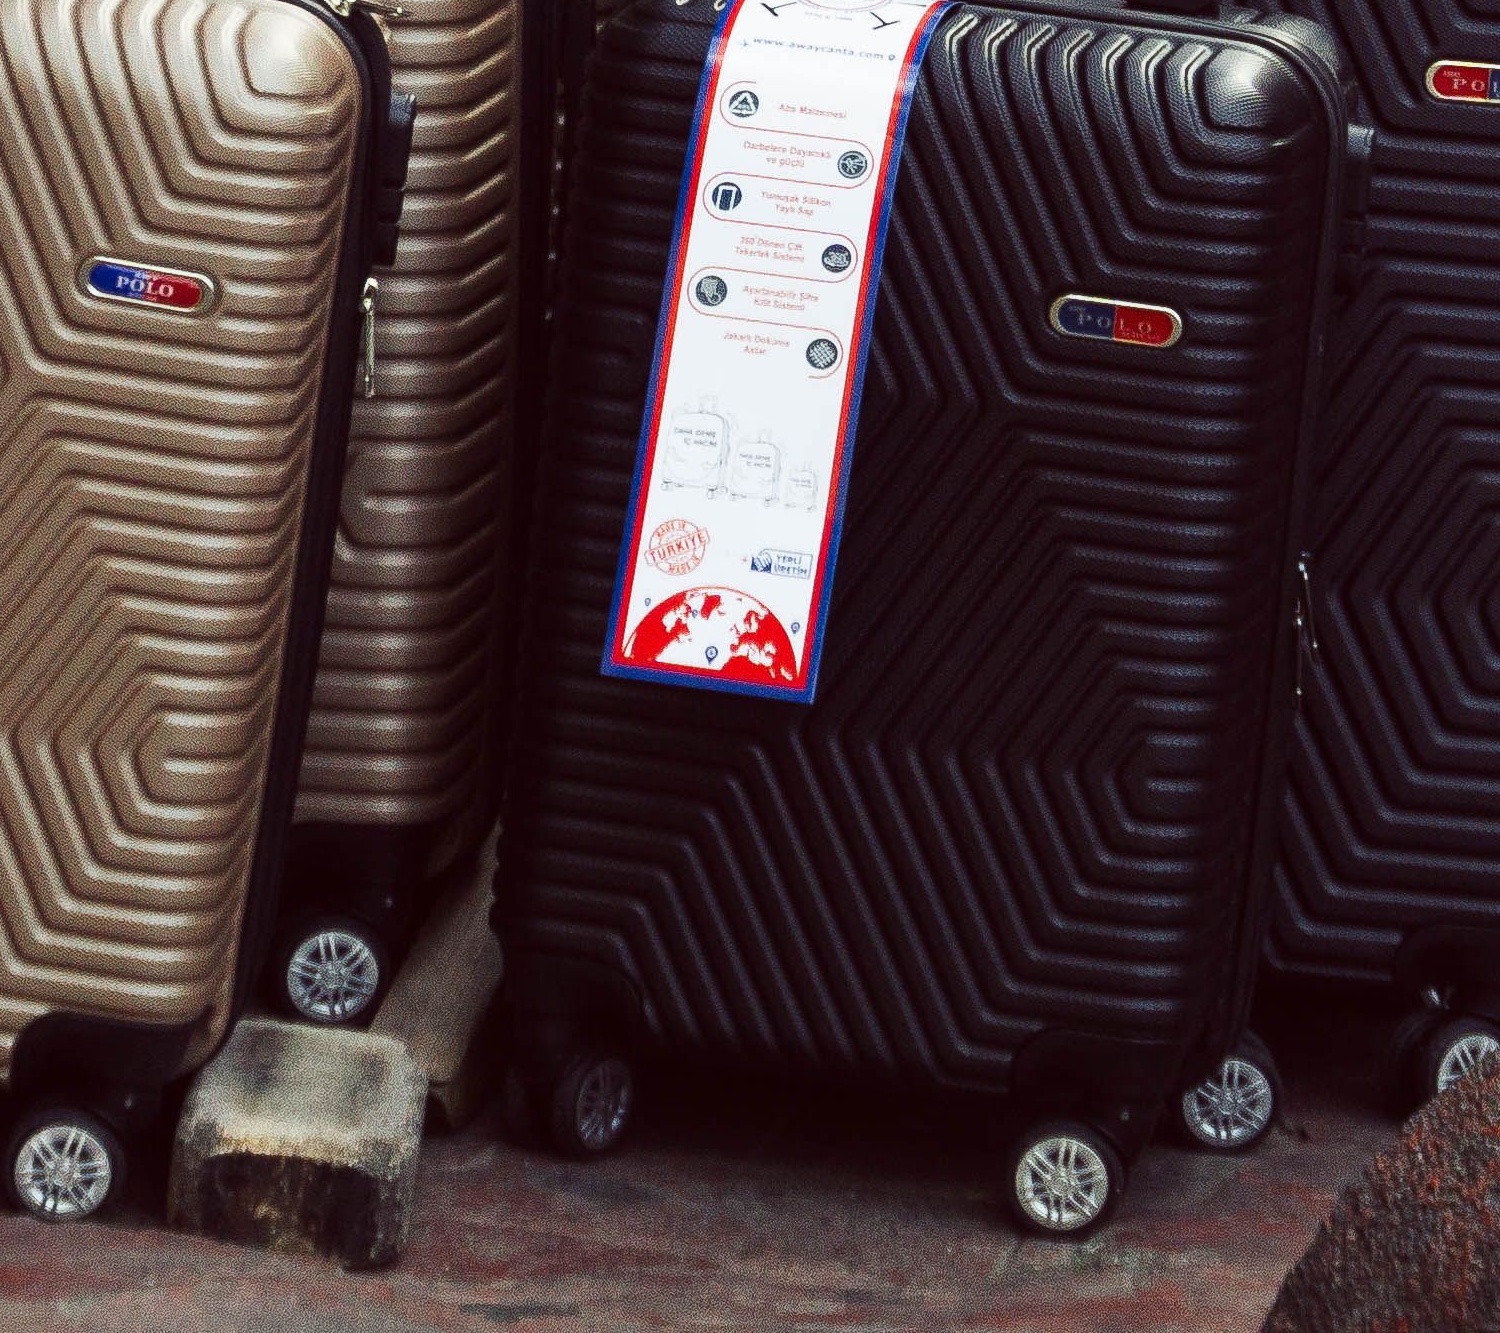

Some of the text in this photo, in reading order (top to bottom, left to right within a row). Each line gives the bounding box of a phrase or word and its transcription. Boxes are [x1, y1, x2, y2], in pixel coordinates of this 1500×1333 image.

[753, 36, 884, 61] www.awaycanta.com
[743, 140, 788, 154] Darbelere
[115, 275, 174, 298] POLO
[1077, 313, 1152, 334] POLO
